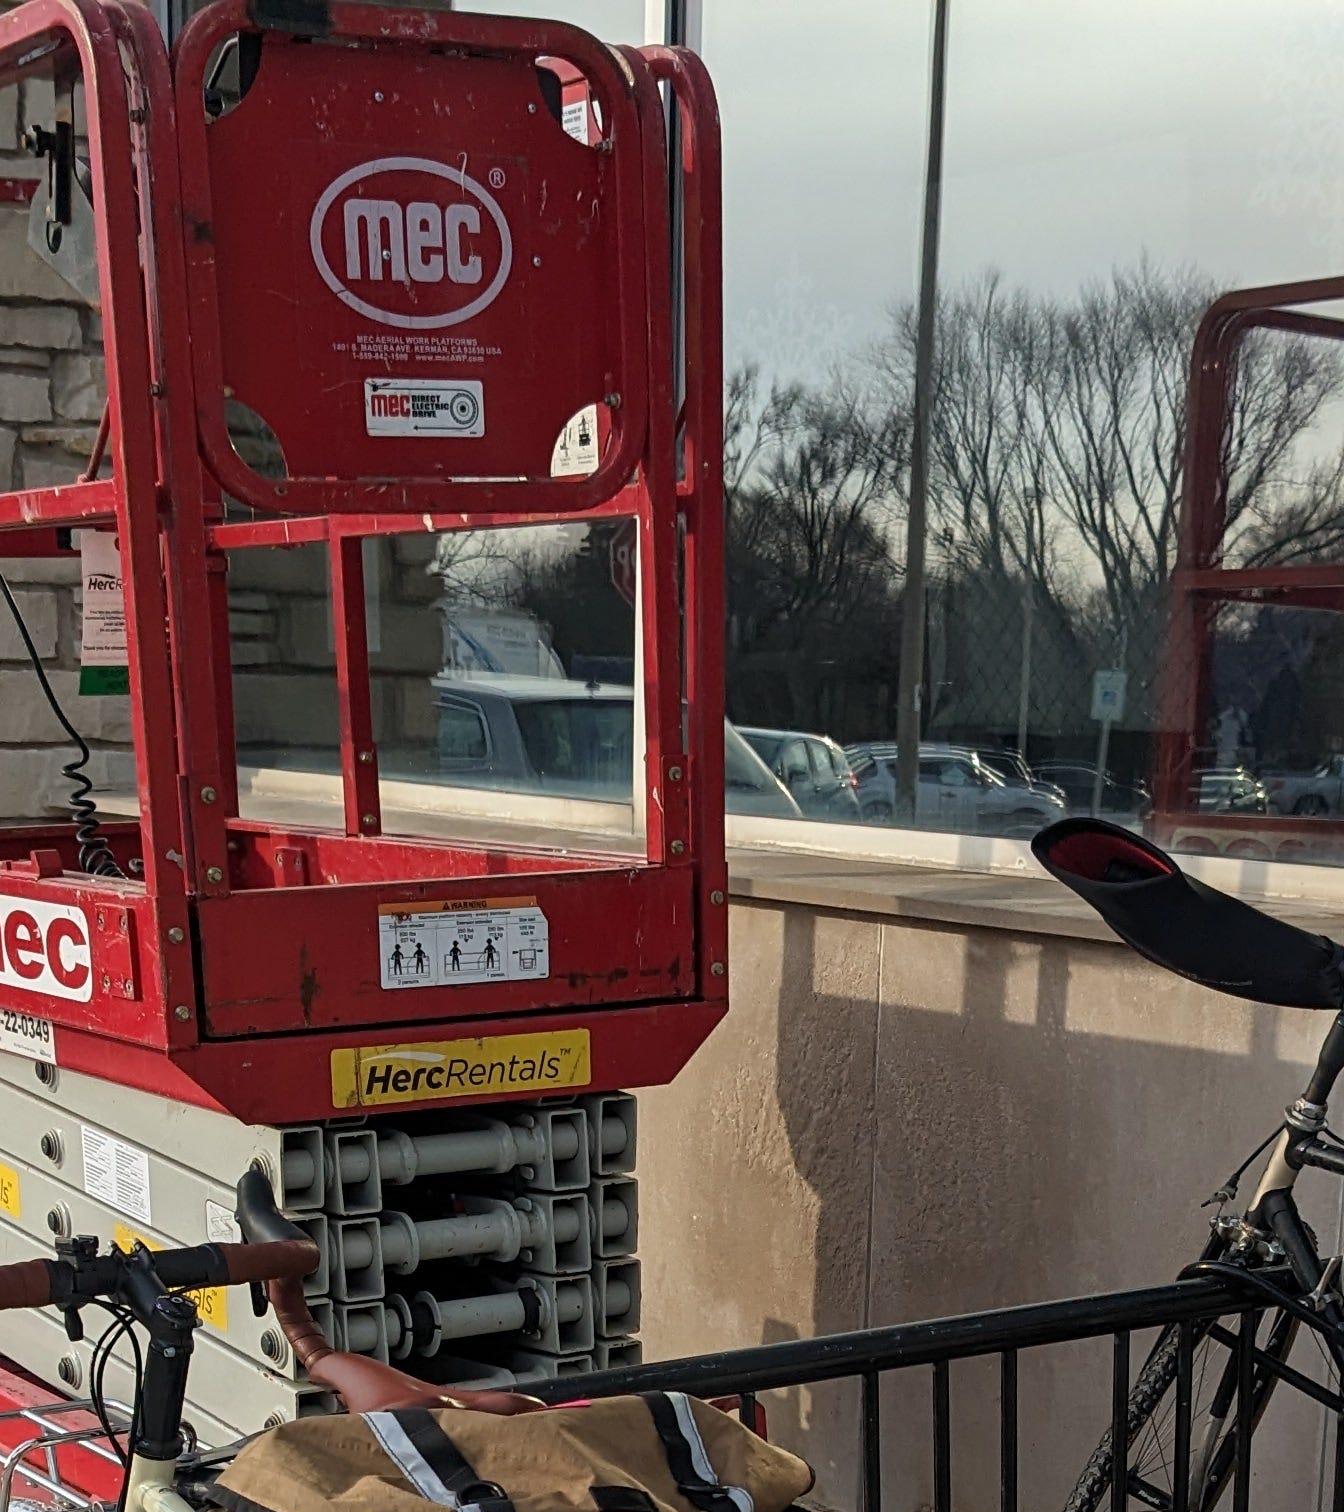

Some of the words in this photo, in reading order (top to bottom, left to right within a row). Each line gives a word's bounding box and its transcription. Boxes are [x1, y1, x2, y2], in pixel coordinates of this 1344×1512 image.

[344, 199, 482, 285] mec
[357, 335, 373, 343] MEC
[376, 336, 404, 345] AERIAL
[405, 337, 429, 345] WORK
[431, 337, 477, 346] PLATFORMS
[361, 343, 394, 352] MADERA
[451, 346, 462, 354] CA
[486, 347, 503, 355] USA
[412, 395, 441, 403] DIRECT
[371, 394, 411, 418] mec
[412, 402, 450, 411] ELECTRIC
[412, 410, 437, 418] DRIVE
[450, 901, 487, 910] WARNING
